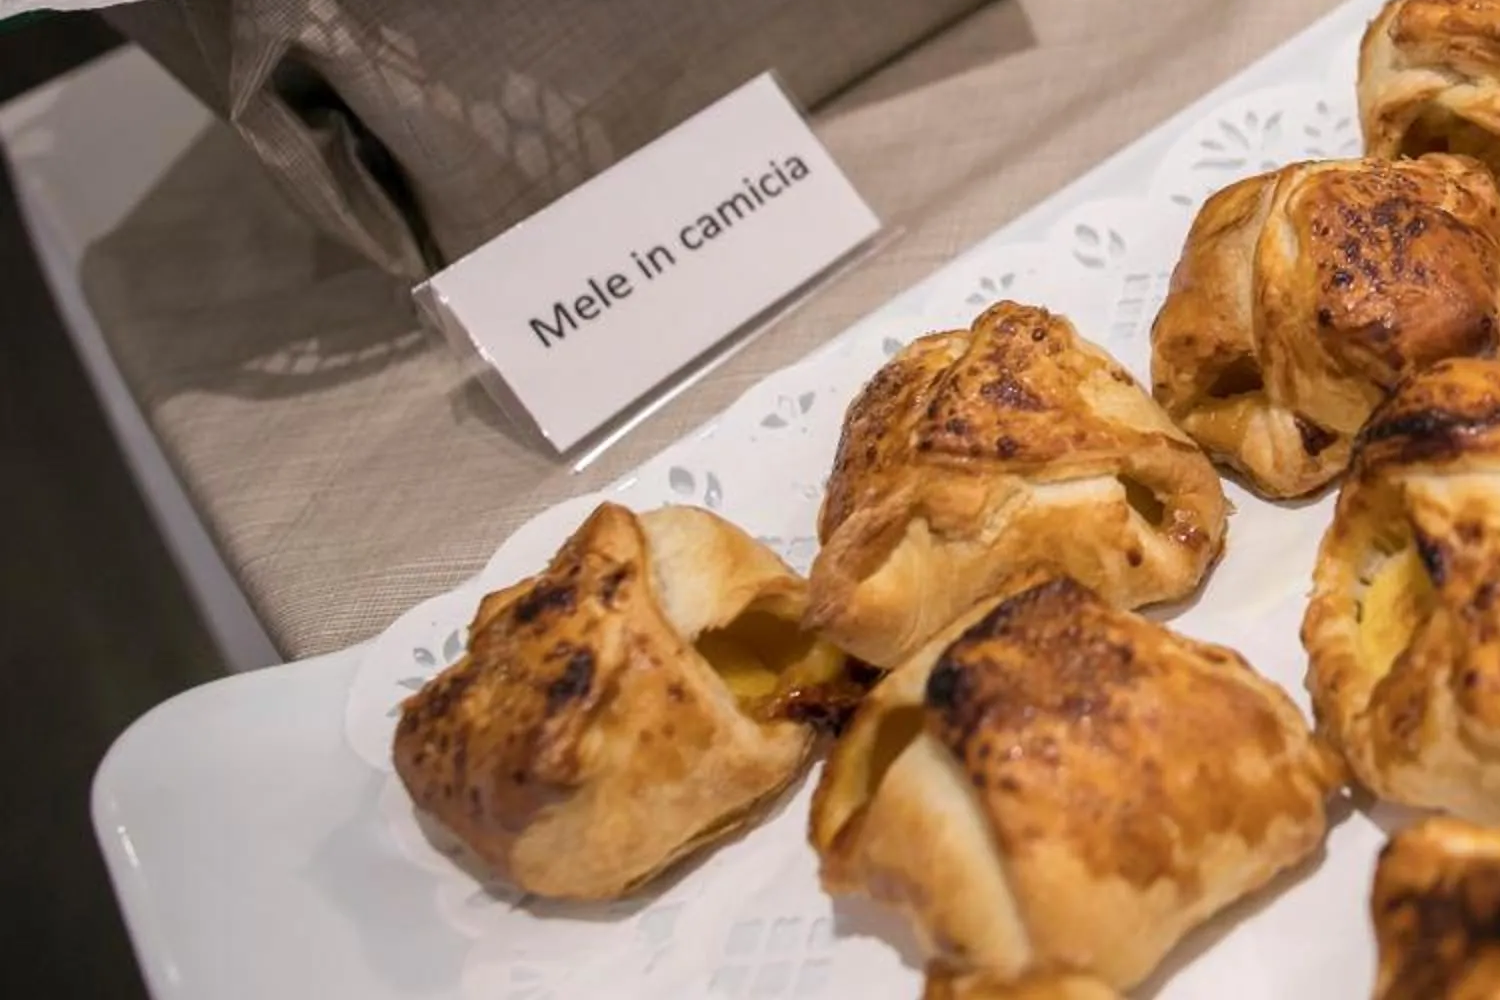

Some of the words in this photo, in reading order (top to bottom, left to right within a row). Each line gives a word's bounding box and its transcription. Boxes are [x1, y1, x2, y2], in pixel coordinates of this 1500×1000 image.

[528, 272, 634, 349] Mele
[630, 244, 677, 281] in
[678, 154, 811, 252] camicia
